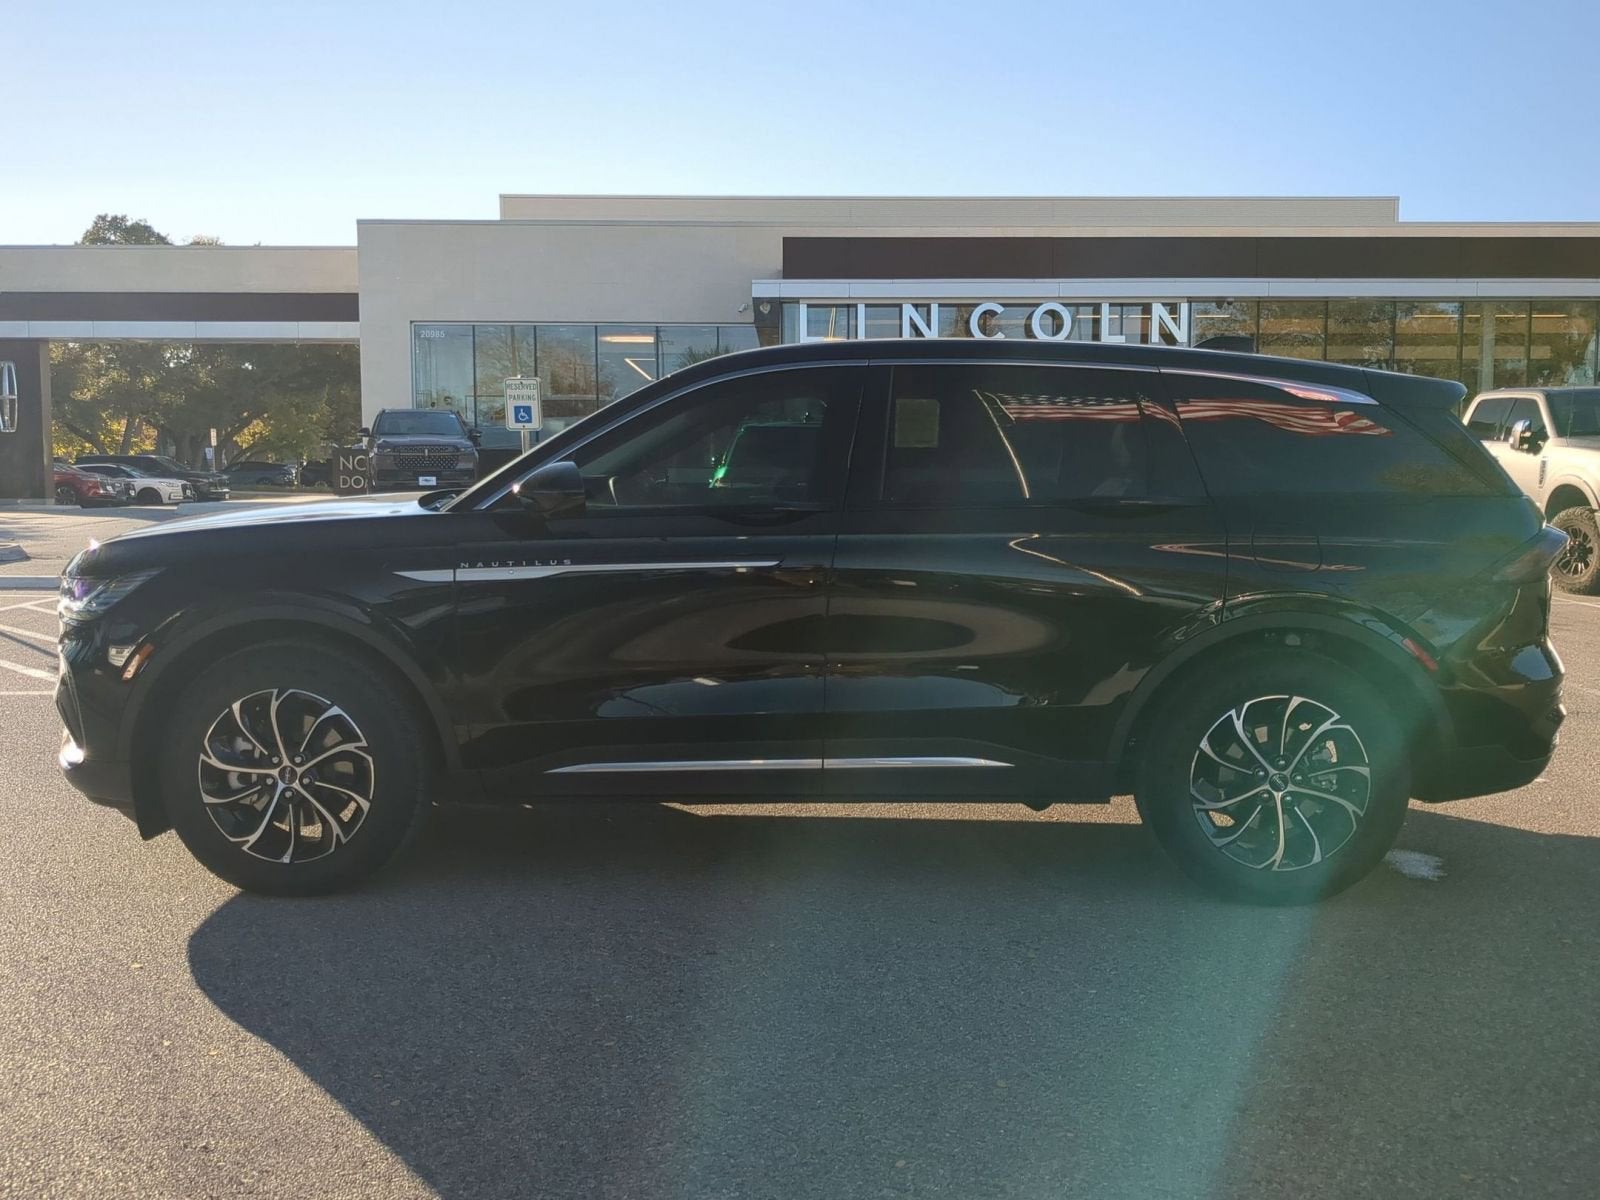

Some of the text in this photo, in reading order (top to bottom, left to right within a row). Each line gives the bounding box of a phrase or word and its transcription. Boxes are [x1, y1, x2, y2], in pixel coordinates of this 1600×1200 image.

[799, 302, 1189, 344] LINCOLN
[506, 383, 537, 391] RESERVED
[460, 559, 572, 569] NAUTILUS
